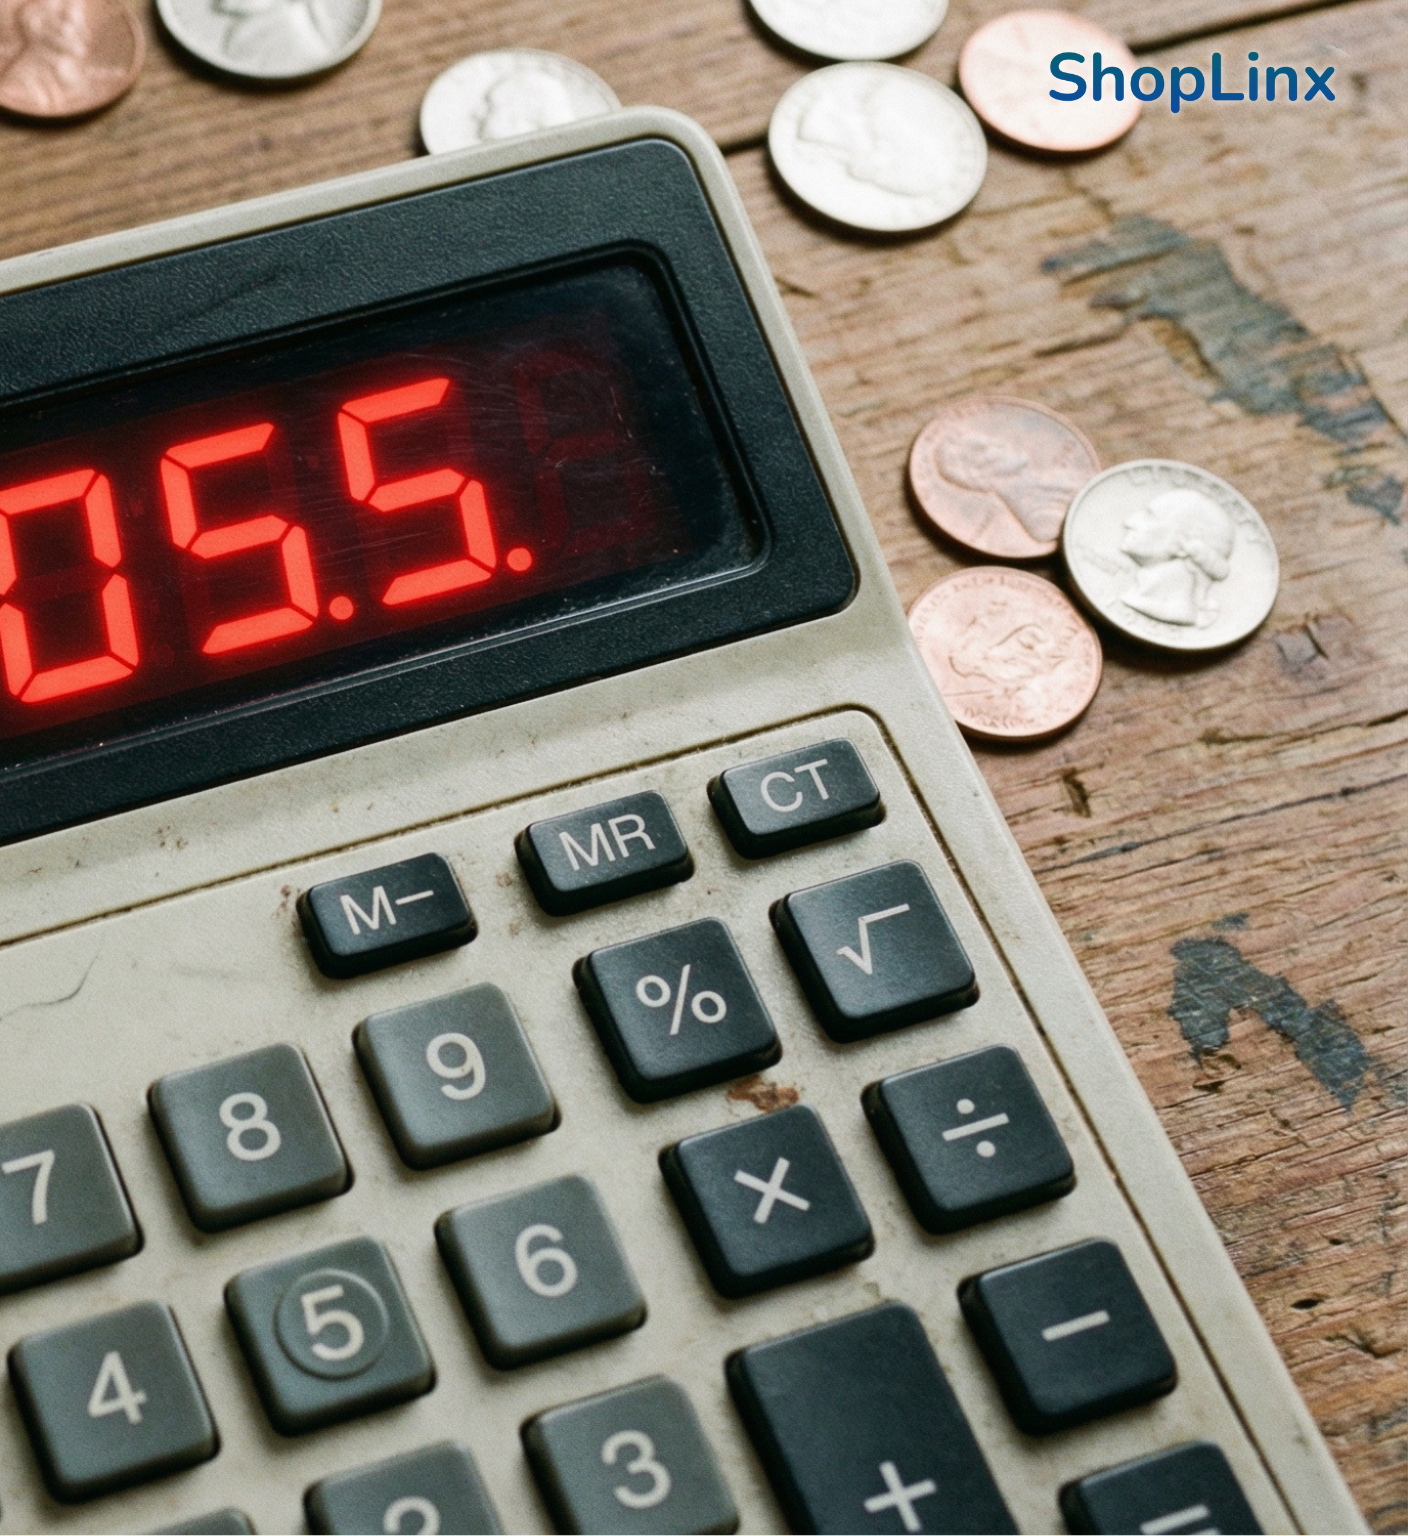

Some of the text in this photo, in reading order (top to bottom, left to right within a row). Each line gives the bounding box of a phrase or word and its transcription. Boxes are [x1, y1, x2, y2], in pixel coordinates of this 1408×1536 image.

[760, 759, 832, 813] CT
[559, 813, 657, 872] MR
[636, 964, 727, 1036] %
[427, 1032, 487, 1101] 9
[219, 1092, 281, 1162] 8
[2, 1149, 55, 1225] 7
[515, 1224, 578, 1298] 6
[300, 1285, 365, 1362] 5
[87, 1351, 146, 1424] 4
[601, 1430, 671, 1509] 3
